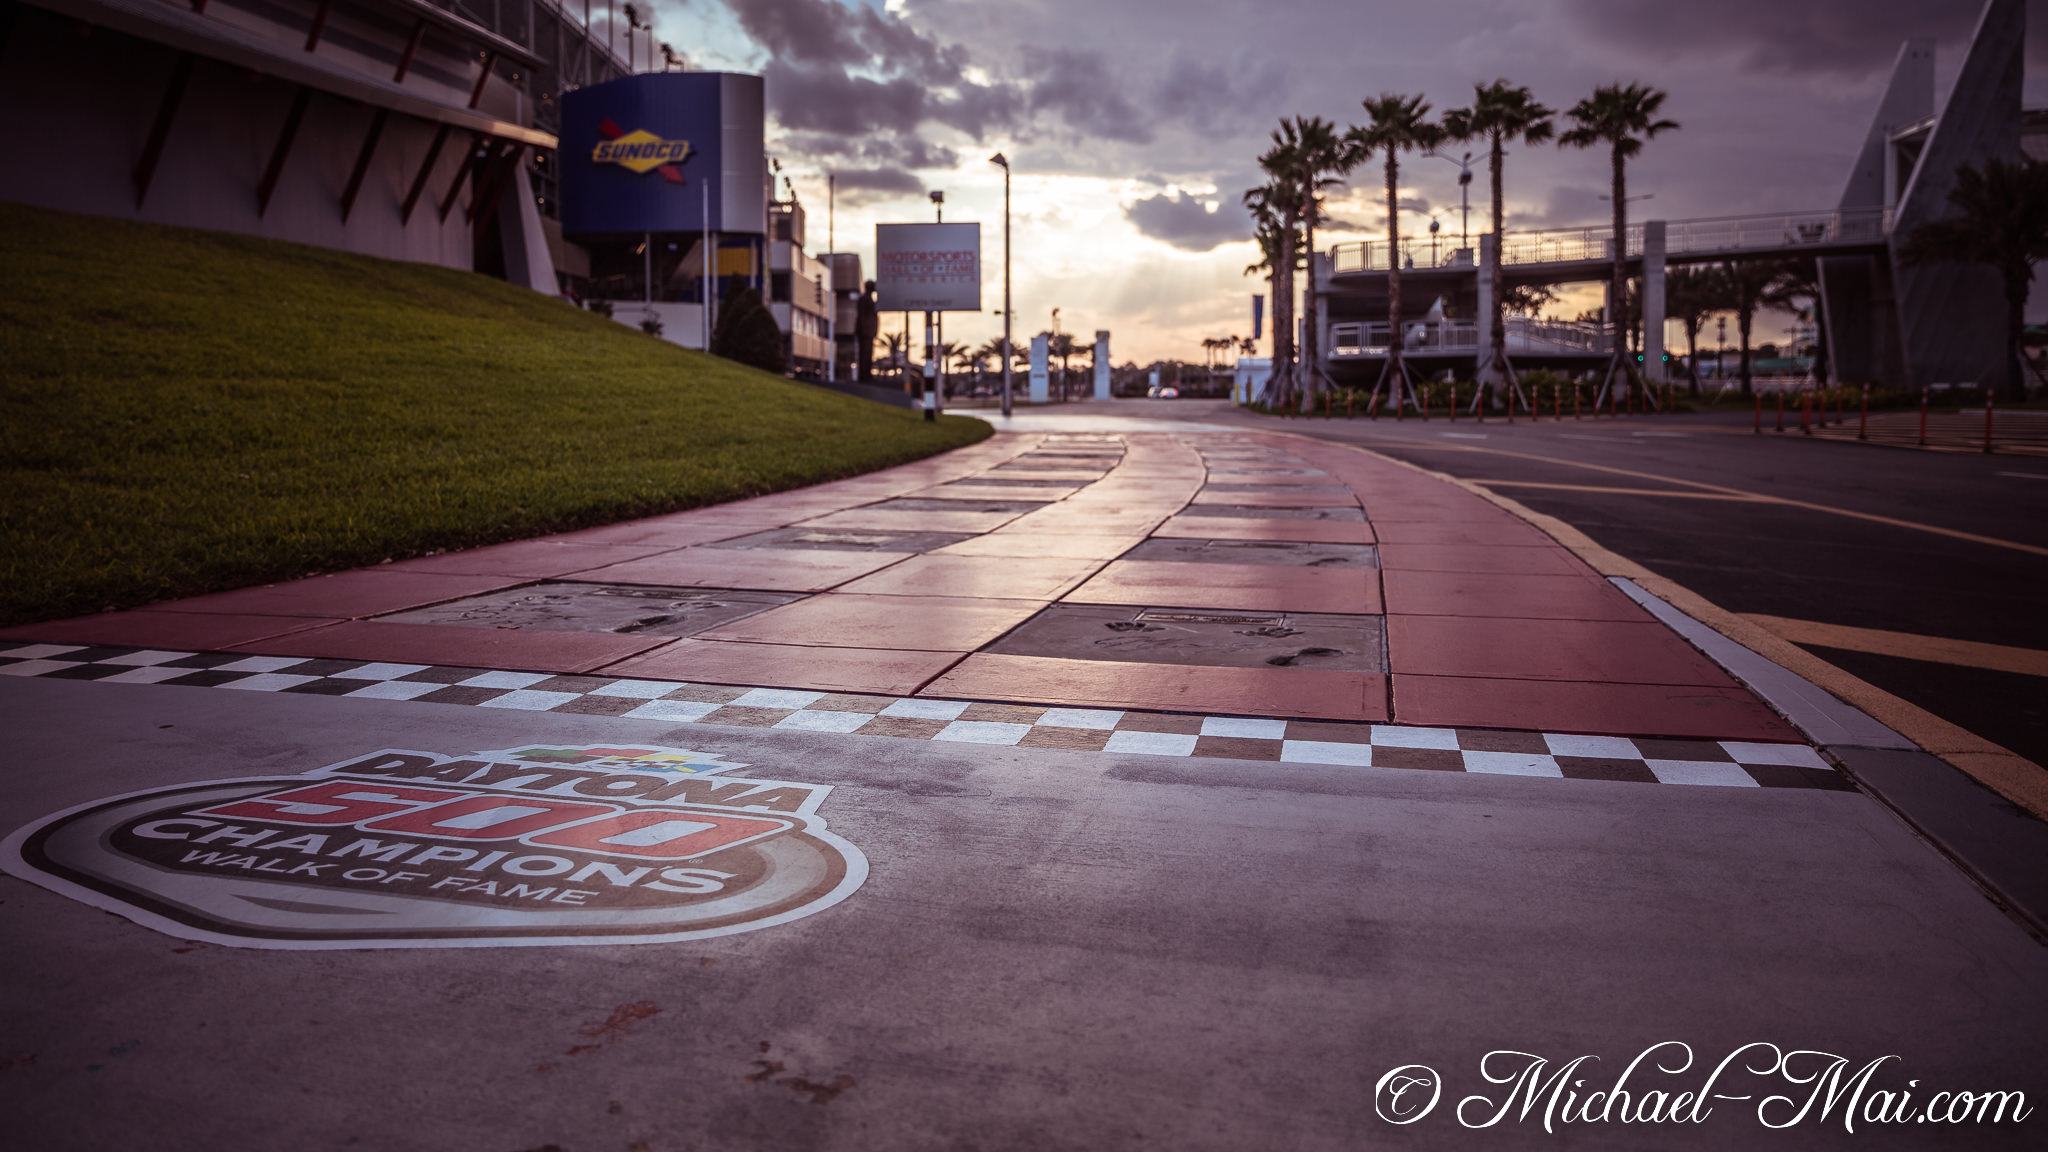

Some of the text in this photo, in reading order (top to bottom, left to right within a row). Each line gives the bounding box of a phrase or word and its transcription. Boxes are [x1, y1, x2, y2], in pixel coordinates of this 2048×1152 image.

[598, 142, 684, 159] SUNOCO
[330, 753, 813, 812] DAYTONA
[200, 782, 785, 858] 500
[180, 850, 600, 905] WALK OF FAME
